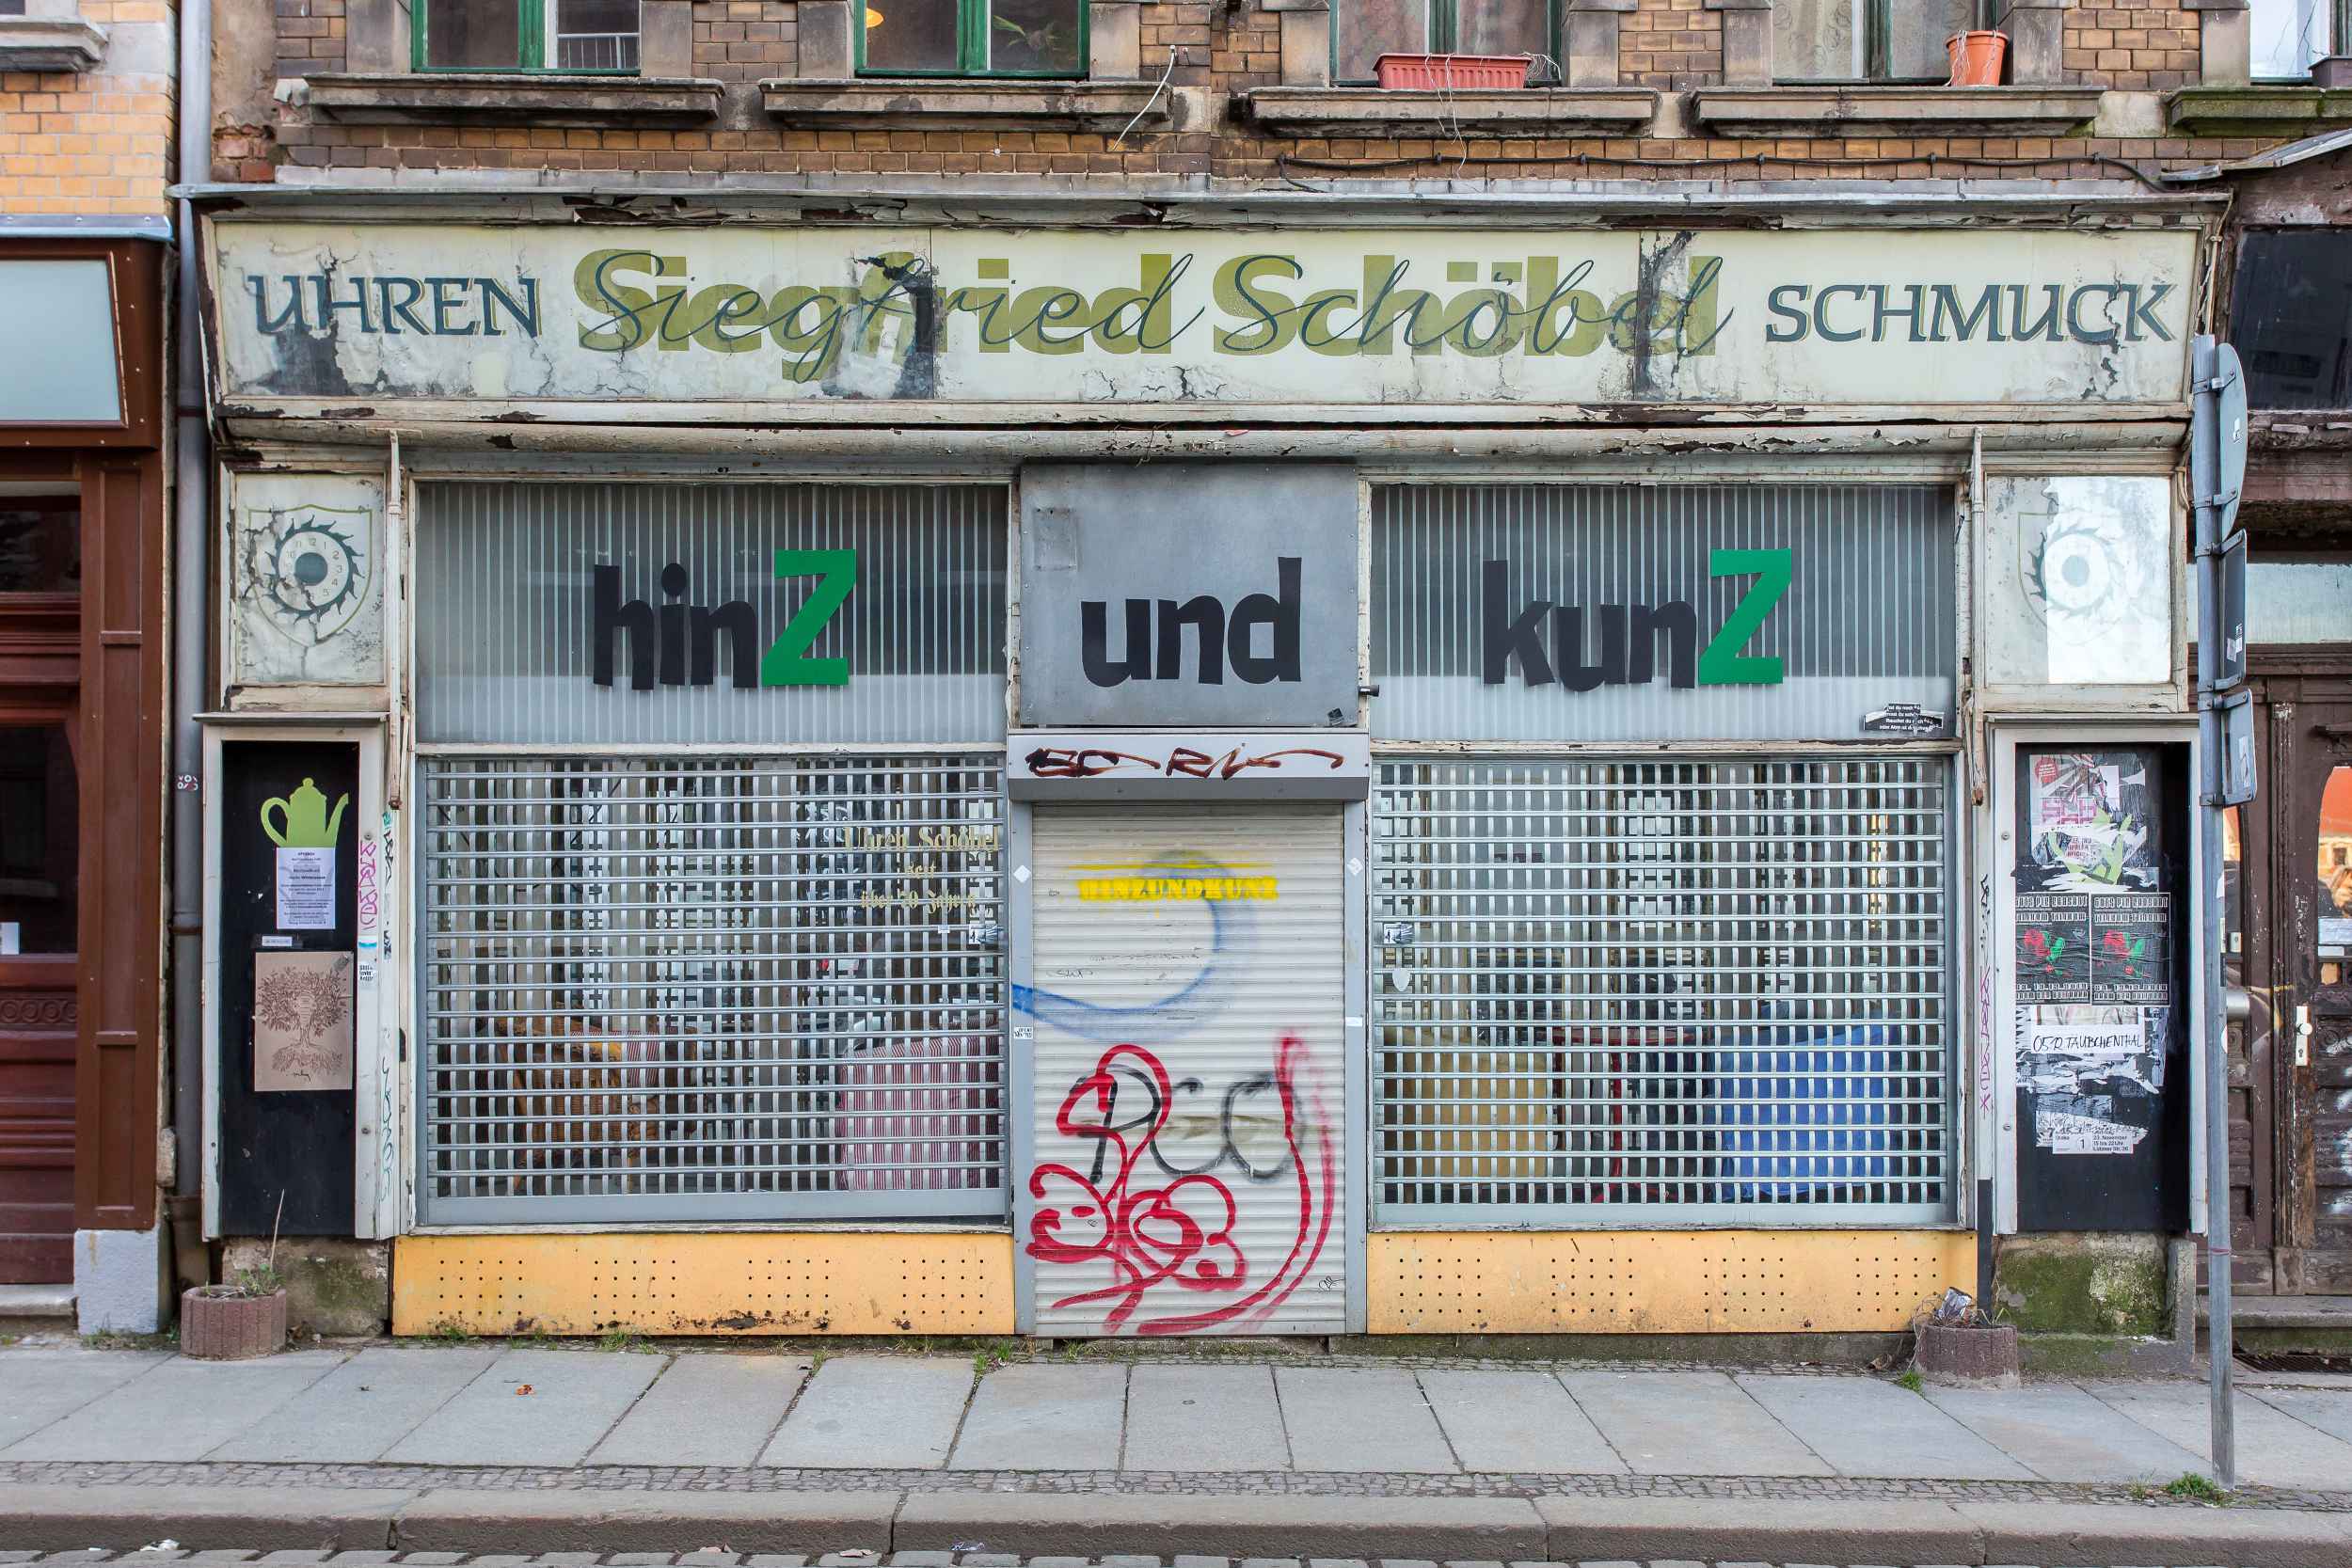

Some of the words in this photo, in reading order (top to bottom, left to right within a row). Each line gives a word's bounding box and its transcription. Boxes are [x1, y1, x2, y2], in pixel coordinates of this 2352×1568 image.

[247, 274, 541, 339] UHREN
[572, 247, 1207, 383] Siegfried
[1212, 252, 1735, 357] Schöbel
[1765, 284, 2175, 343] SCHMUCK
[593, 548, 856, 691] hinZ
[1080, 556, 1302, 688] und
[1483, 548, 1792, 692] kunZ
